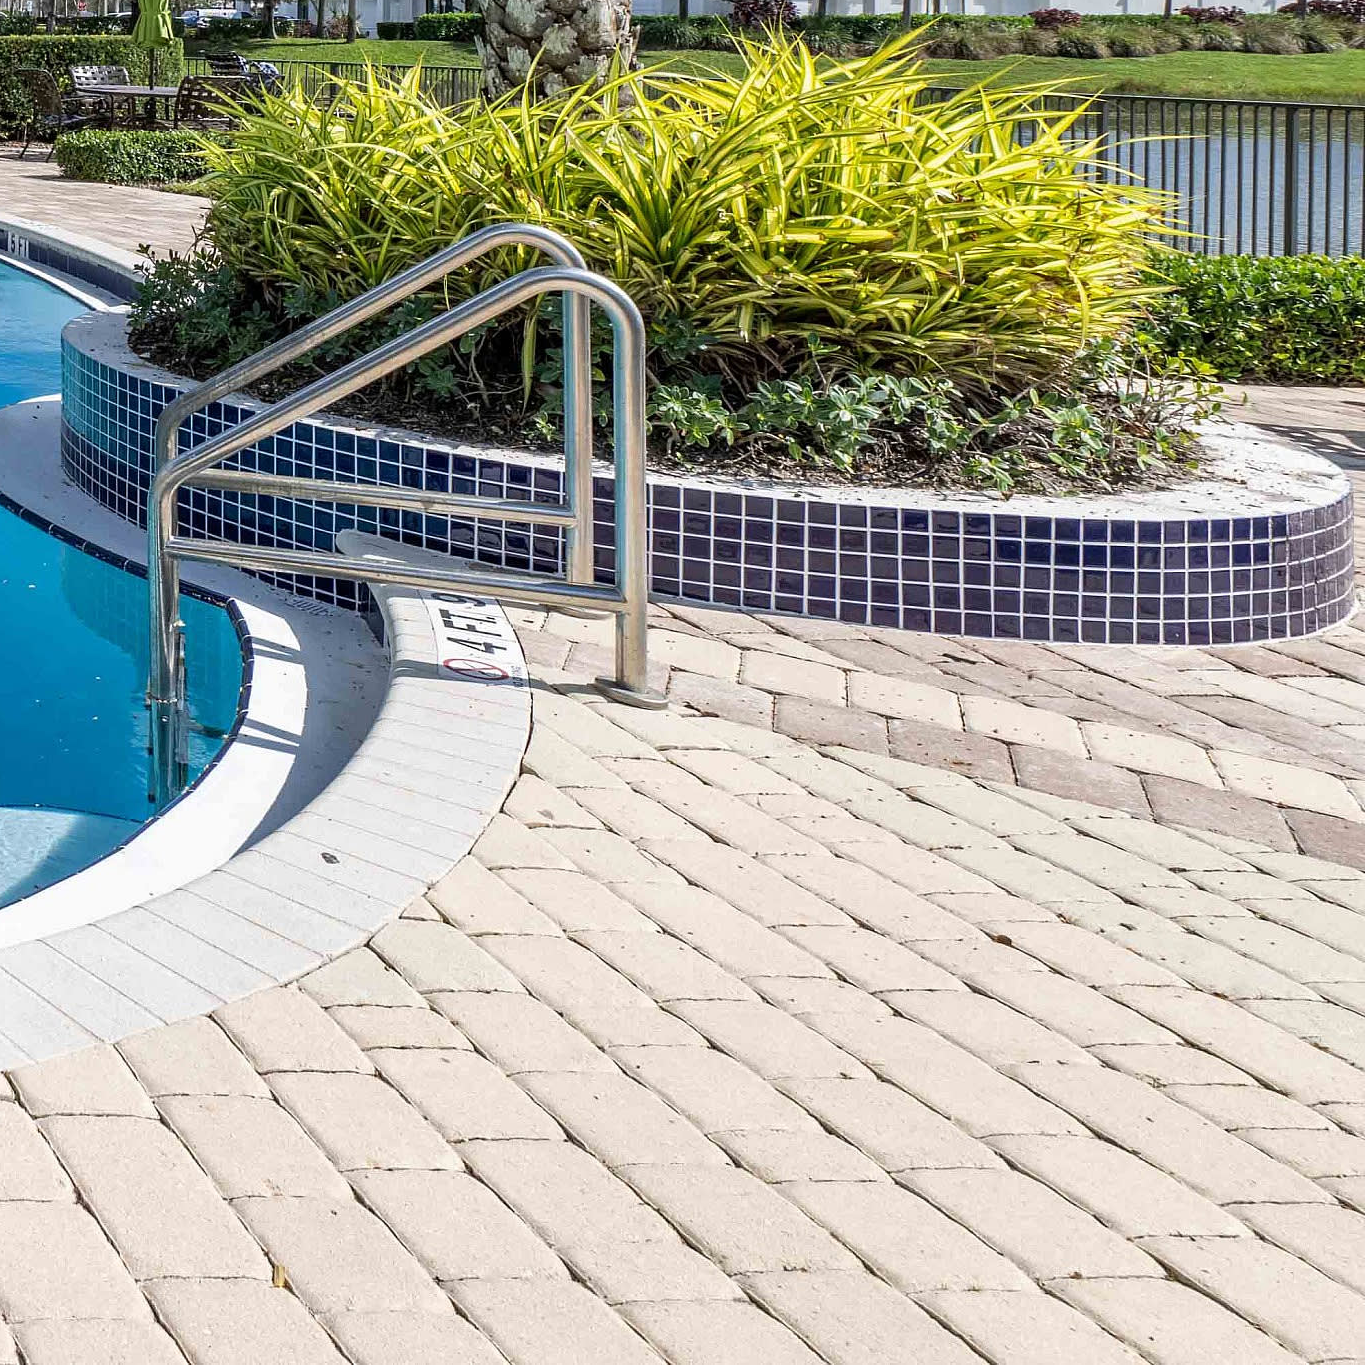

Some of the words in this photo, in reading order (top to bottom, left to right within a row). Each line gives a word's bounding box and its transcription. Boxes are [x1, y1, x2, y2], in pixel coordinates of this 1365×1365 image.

[10, 233, 15, 253] 5
[18, 235, 28, 256] FT
[446, 637, 507, 654] 4
